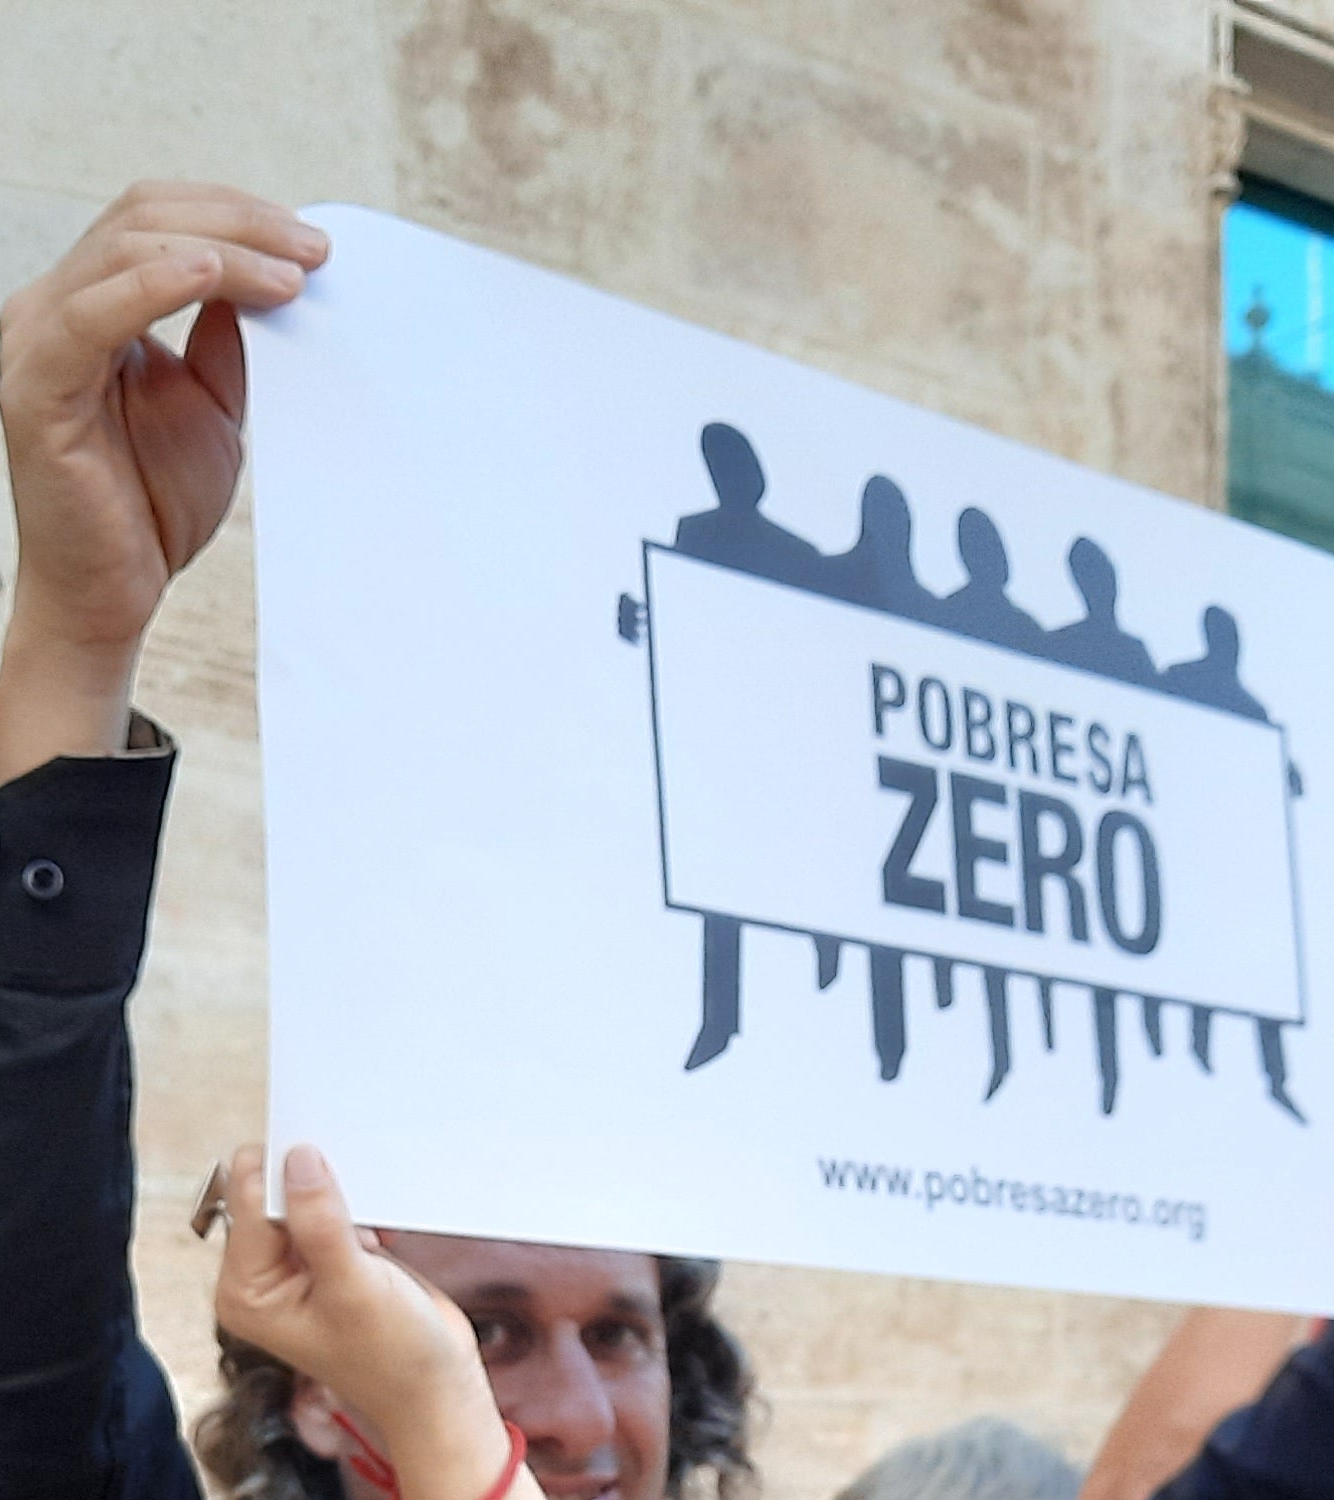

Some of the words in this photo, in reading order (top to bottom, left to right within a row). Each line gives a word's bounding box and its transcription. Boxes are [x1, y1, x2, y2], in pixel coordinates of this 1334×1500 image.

[871, 662, 1154, 805] POBRESA
[876, 754, 1161, 955] ZERO
[818, 1155, 1208, 1241] www.pobresazero.org
